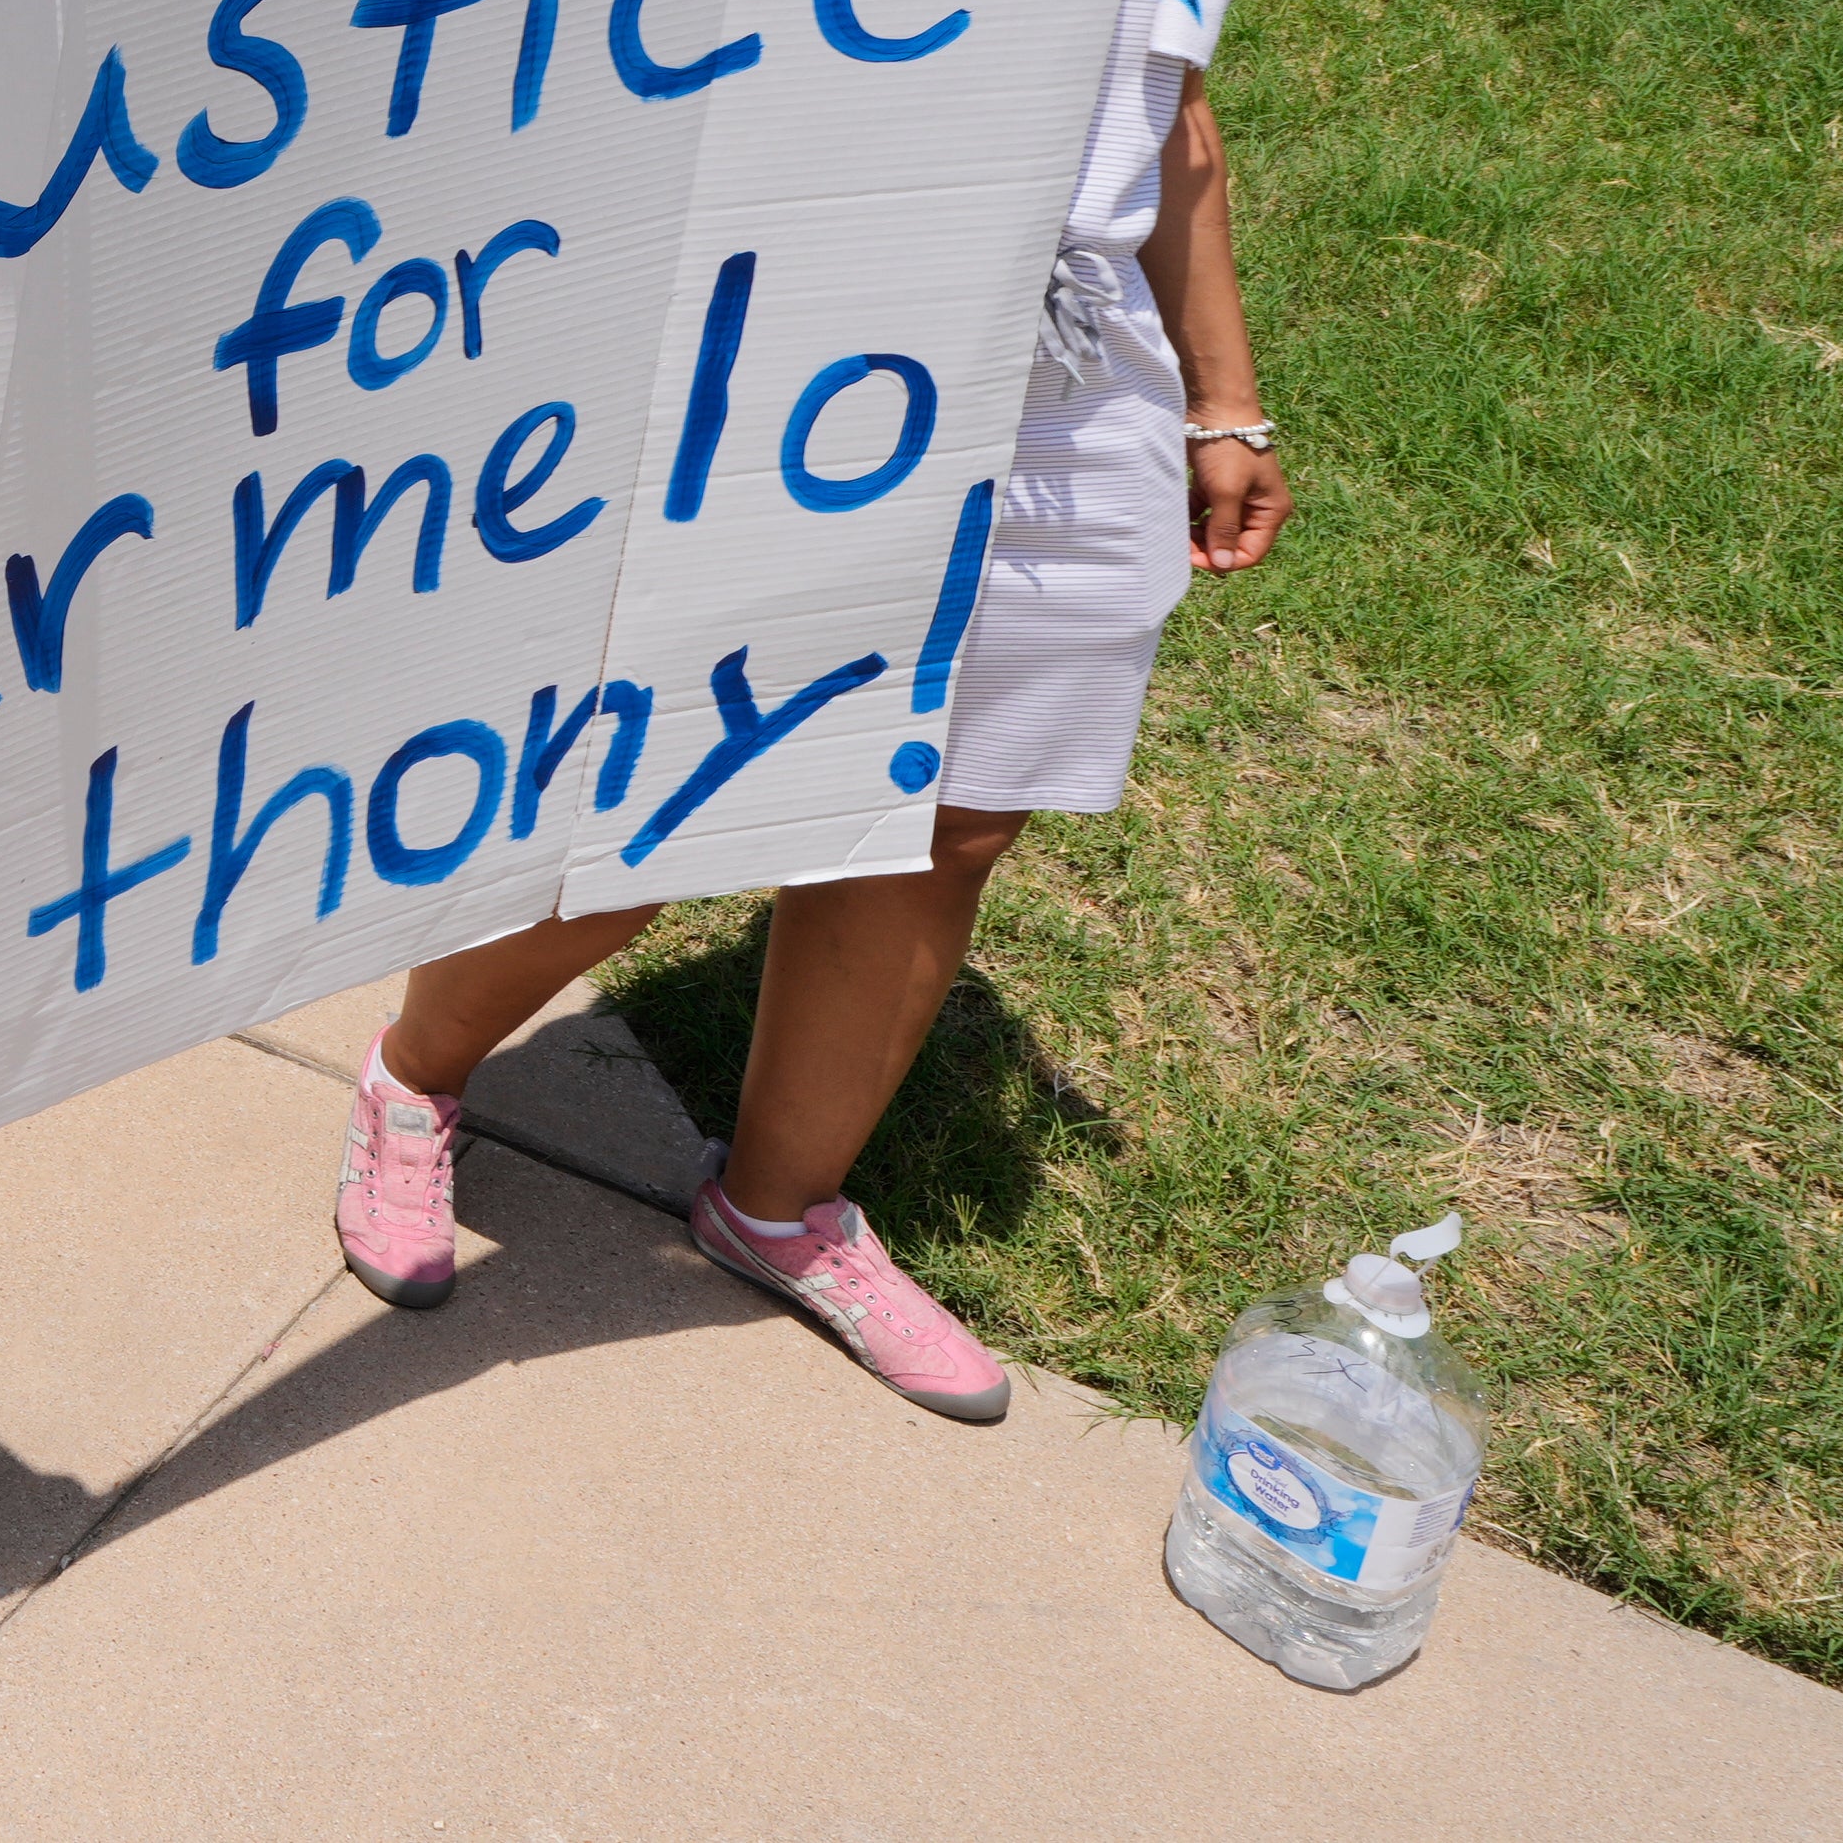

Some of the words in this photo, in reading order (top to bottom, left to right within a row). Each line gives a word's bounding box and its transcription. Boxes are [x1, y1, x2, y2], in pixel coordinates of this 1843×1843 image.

[213, 198, 561, 435] for
[1250, 1468, 1300, 1509] Drinking
[1255, 1482, 1290, 1512] Water
